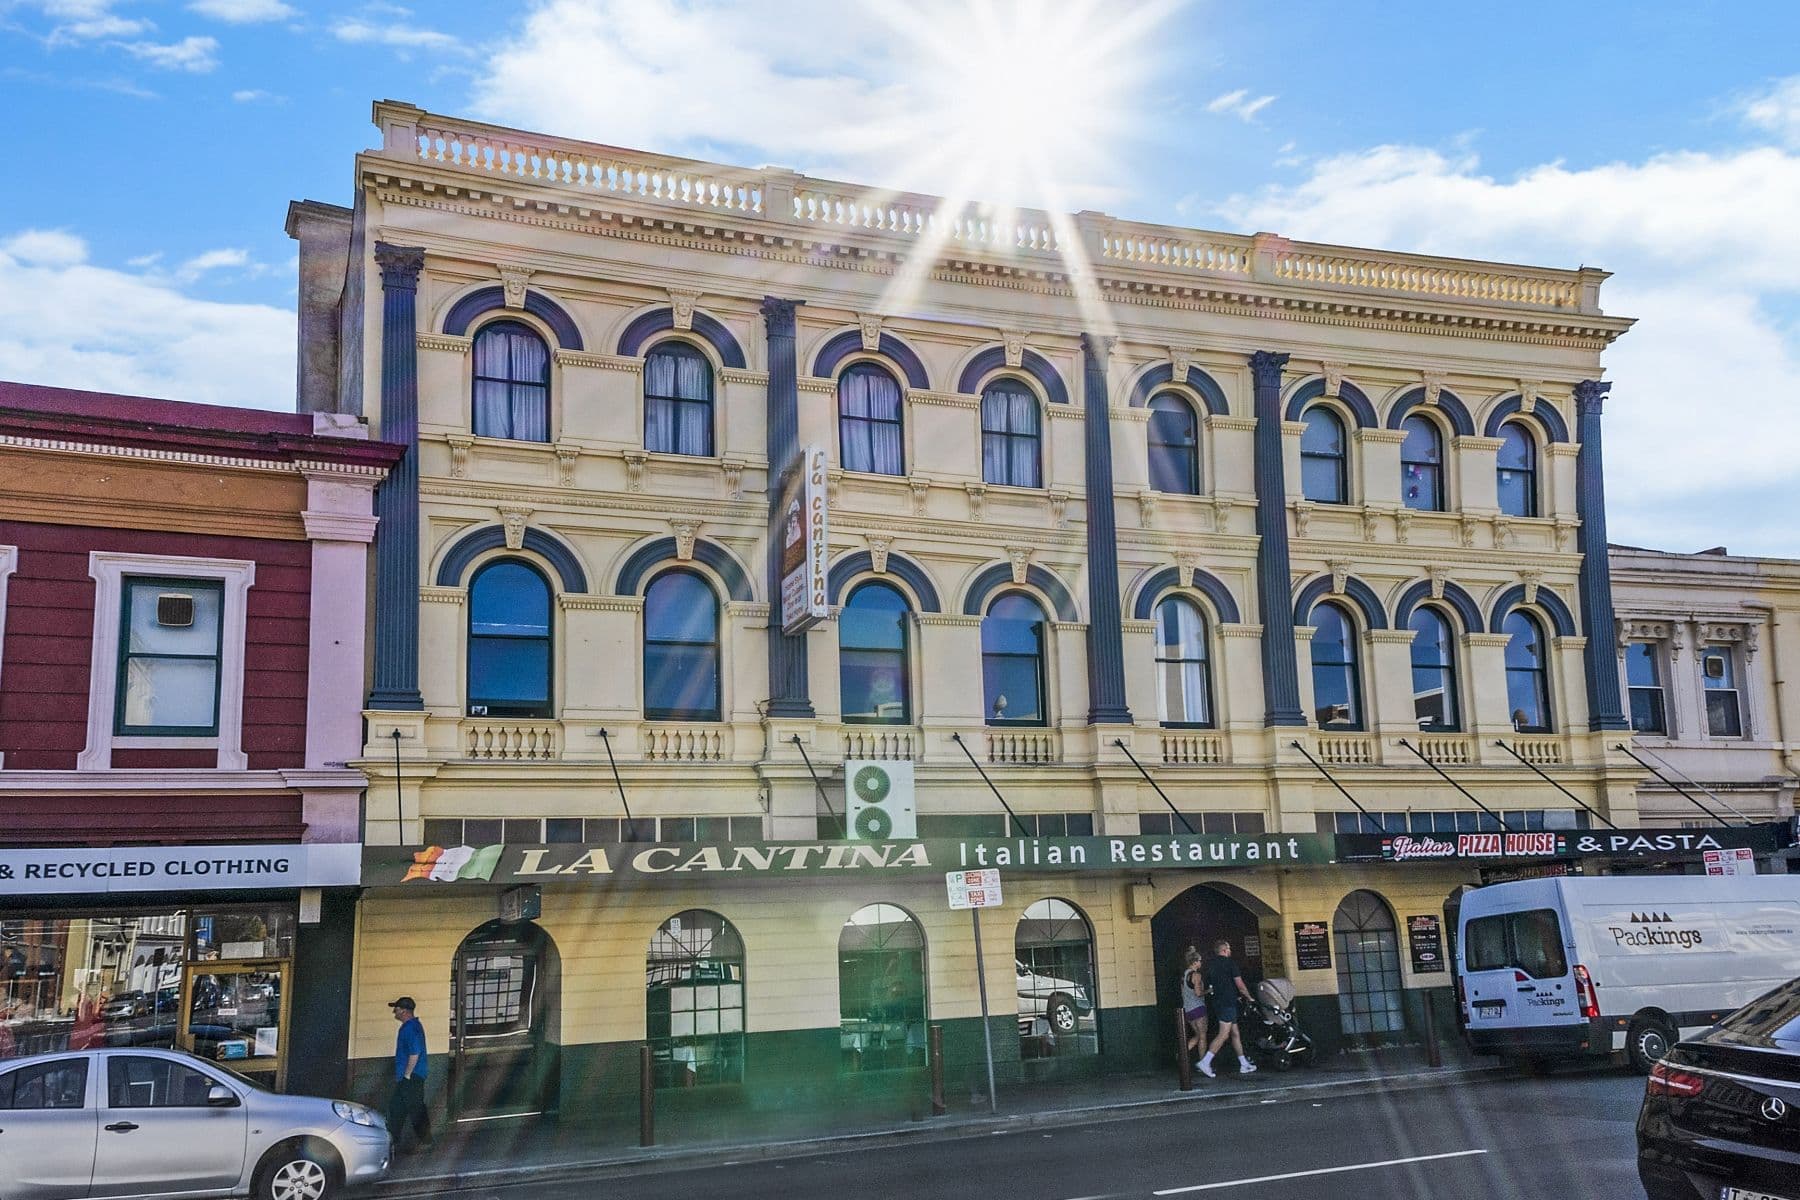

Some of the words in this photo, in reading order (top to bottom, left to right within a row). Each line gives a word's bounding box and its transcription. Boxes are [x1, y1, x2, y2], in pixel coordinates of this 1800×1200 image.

[812, 496, 825, 606] cantina
[513, 848, 614, 875] LA
[631, 843, 932, 873] CANTINA
[960, 839, 1087, 866] Italian
[1110, 837, 1300, 863] Restaurant
[1393, 836, 1455, 861] Italian
[1458, 834, 1502, 856] PIZZA
[1505, 833, 1555, 855] HOUSE
[1577, 836, 1603, 852] &
[1610, 834, 1722, 851] PASTA
[0, 863, 14, 879] &
[24, 861, 155, 879] RECYCLED
[164, 858, 289, 875] CLOTHING
[1608, 926, 1703, 949] Packings
